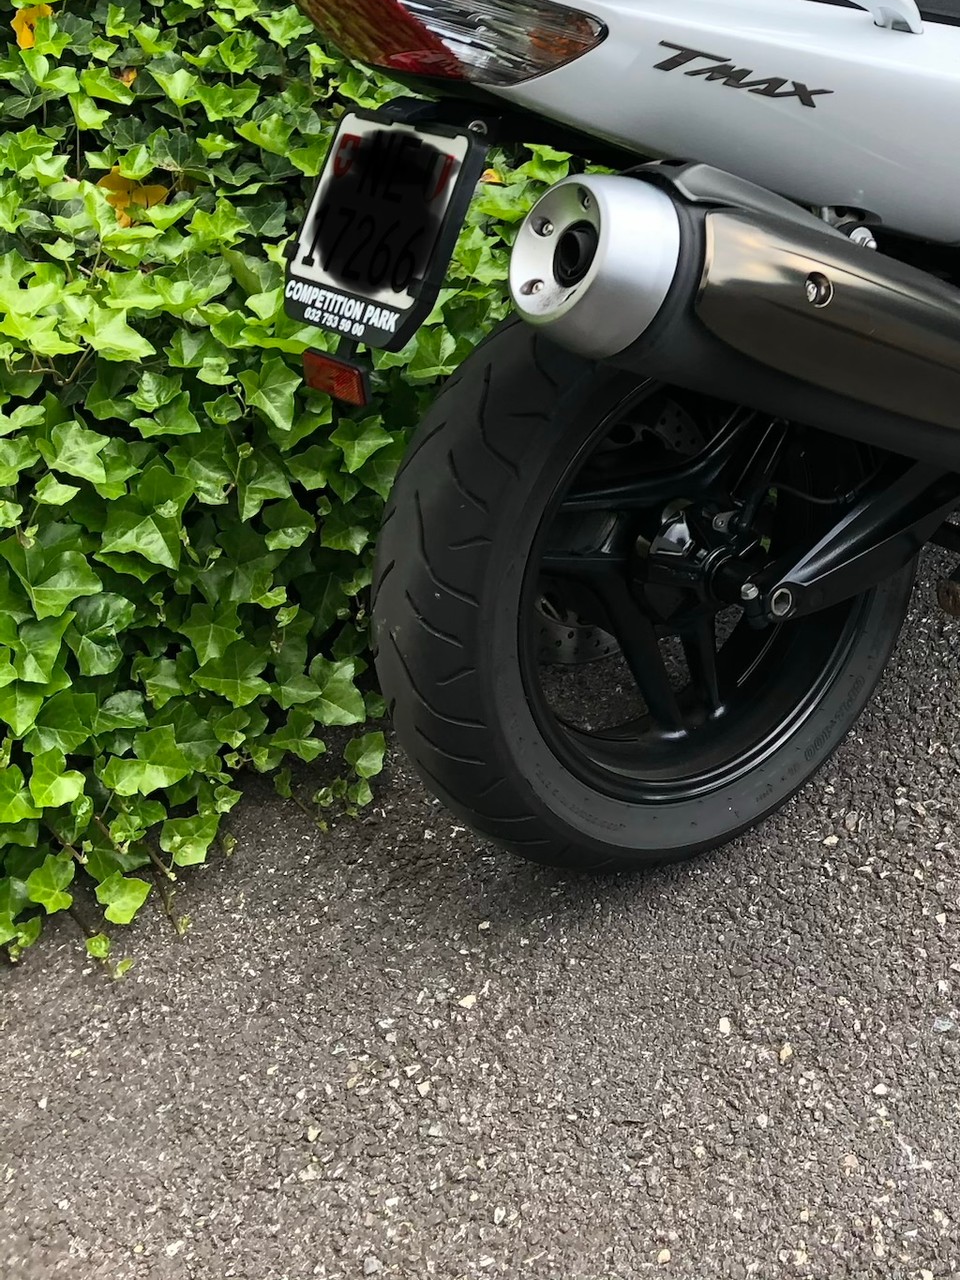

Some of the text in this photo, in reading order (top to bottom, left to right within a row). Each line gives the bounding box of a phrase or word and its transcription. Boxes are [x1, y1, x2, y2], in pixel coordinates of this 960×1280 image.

[653, 40, 834, 108] TMAX
[285, 279, 400, 333] COMPETITION PARK
[304, 306, 322, 322] 032
[321, 312, 340, 328] 753
[351, 322, 365, 337] 00
